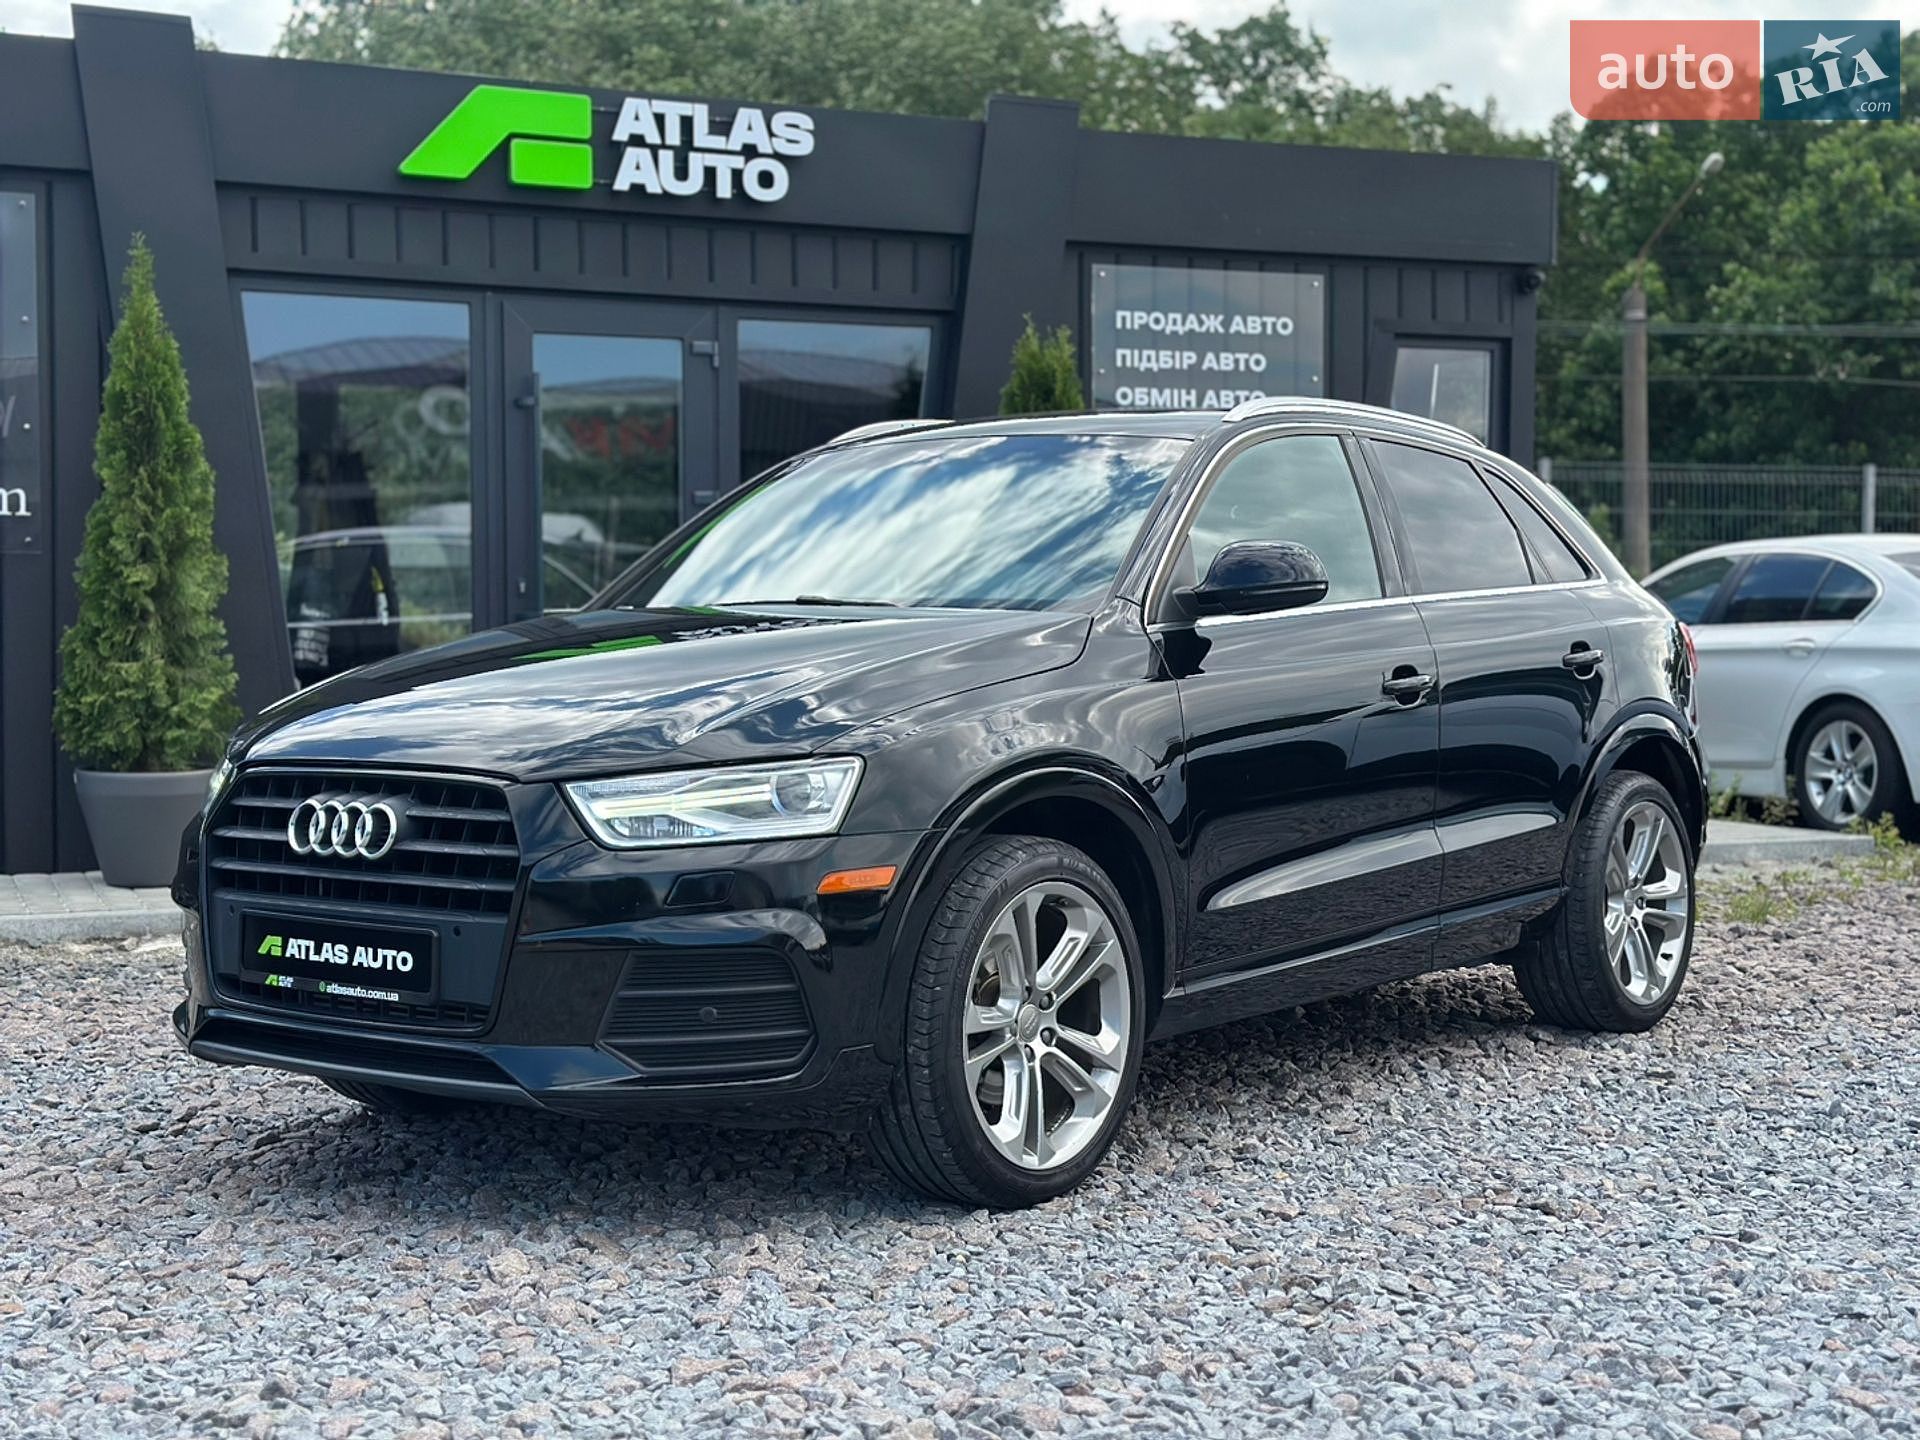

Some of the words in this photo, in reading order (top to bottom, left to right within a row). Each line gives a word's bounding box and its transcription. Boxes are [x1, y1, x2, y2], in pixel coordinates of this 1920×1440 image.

[612, 97, 815, 156] ATLAS
[612, 146, 789, 203] AUTO
[1115, 310, 1225, 335] ПРОДАЖ
[1229, 315, 1294, 336] АВТО
[1115, 348, 1198, 372] ПІДБІР
[1202, 351, 1267, 373] АВТО
[1115, 386, 1197, 408] ОБМІН
[285, 938, 349, 965] ATLAS
[352, 946, 413, 972] AUTO
[326, 983, 399, 1001] atlasauto.com.ua
